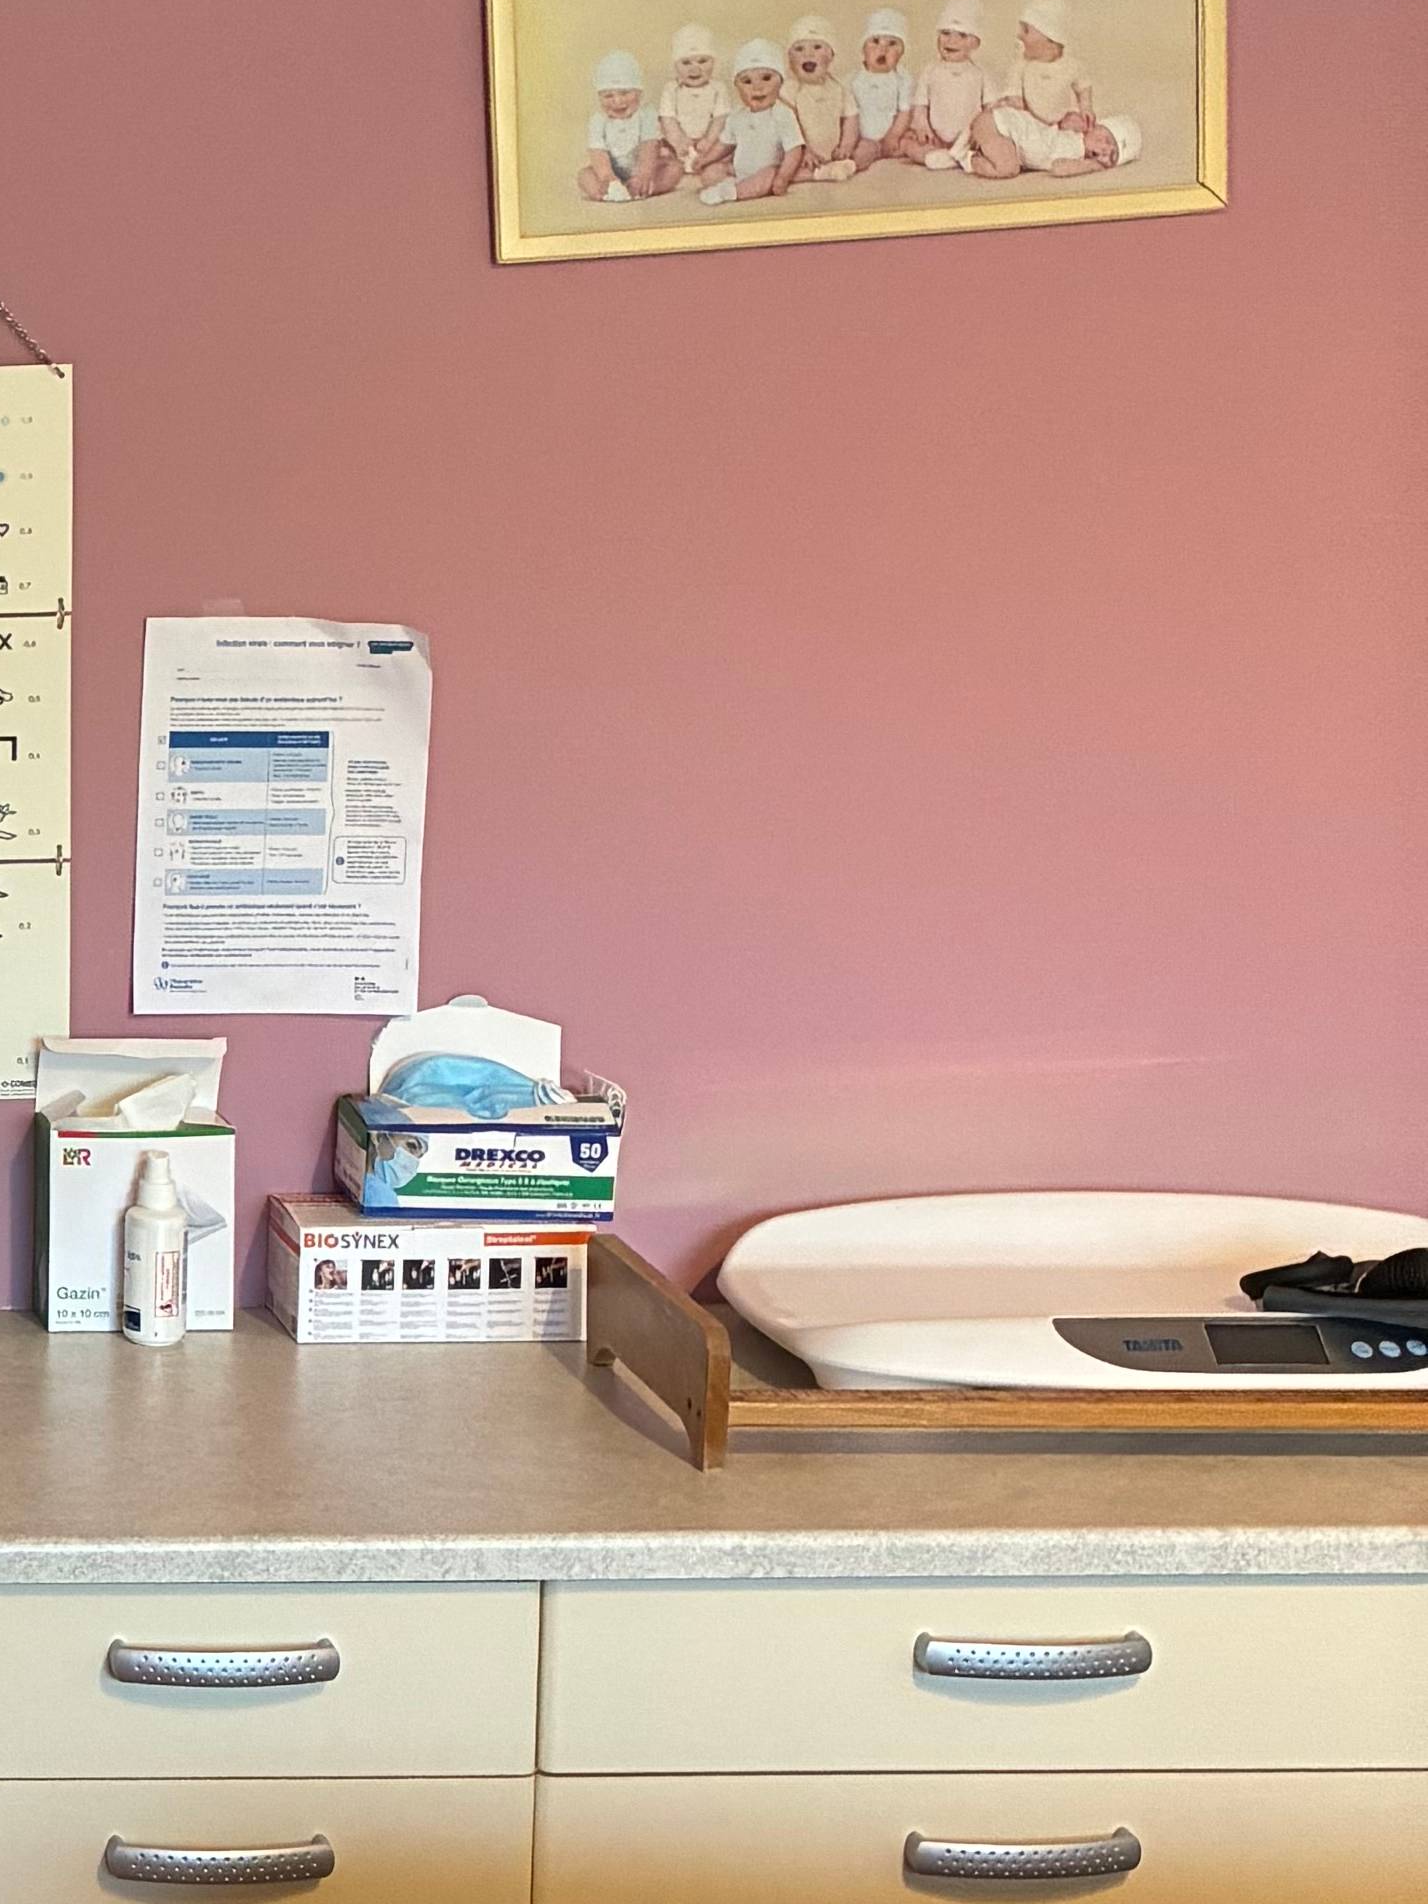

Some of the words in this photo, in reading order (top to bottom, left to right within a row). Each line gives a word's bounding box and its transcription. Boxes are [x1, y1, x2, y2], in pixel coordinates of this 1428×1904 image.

[455, 1147, 546, 1163] DREXCO
[579, 1143, 602, 1159] 50
[304, 1232, 400, 1249] BIOSYNEX
[57, 1309, 69, 1318] 10
[80, 1309, 92, 1318] 10
